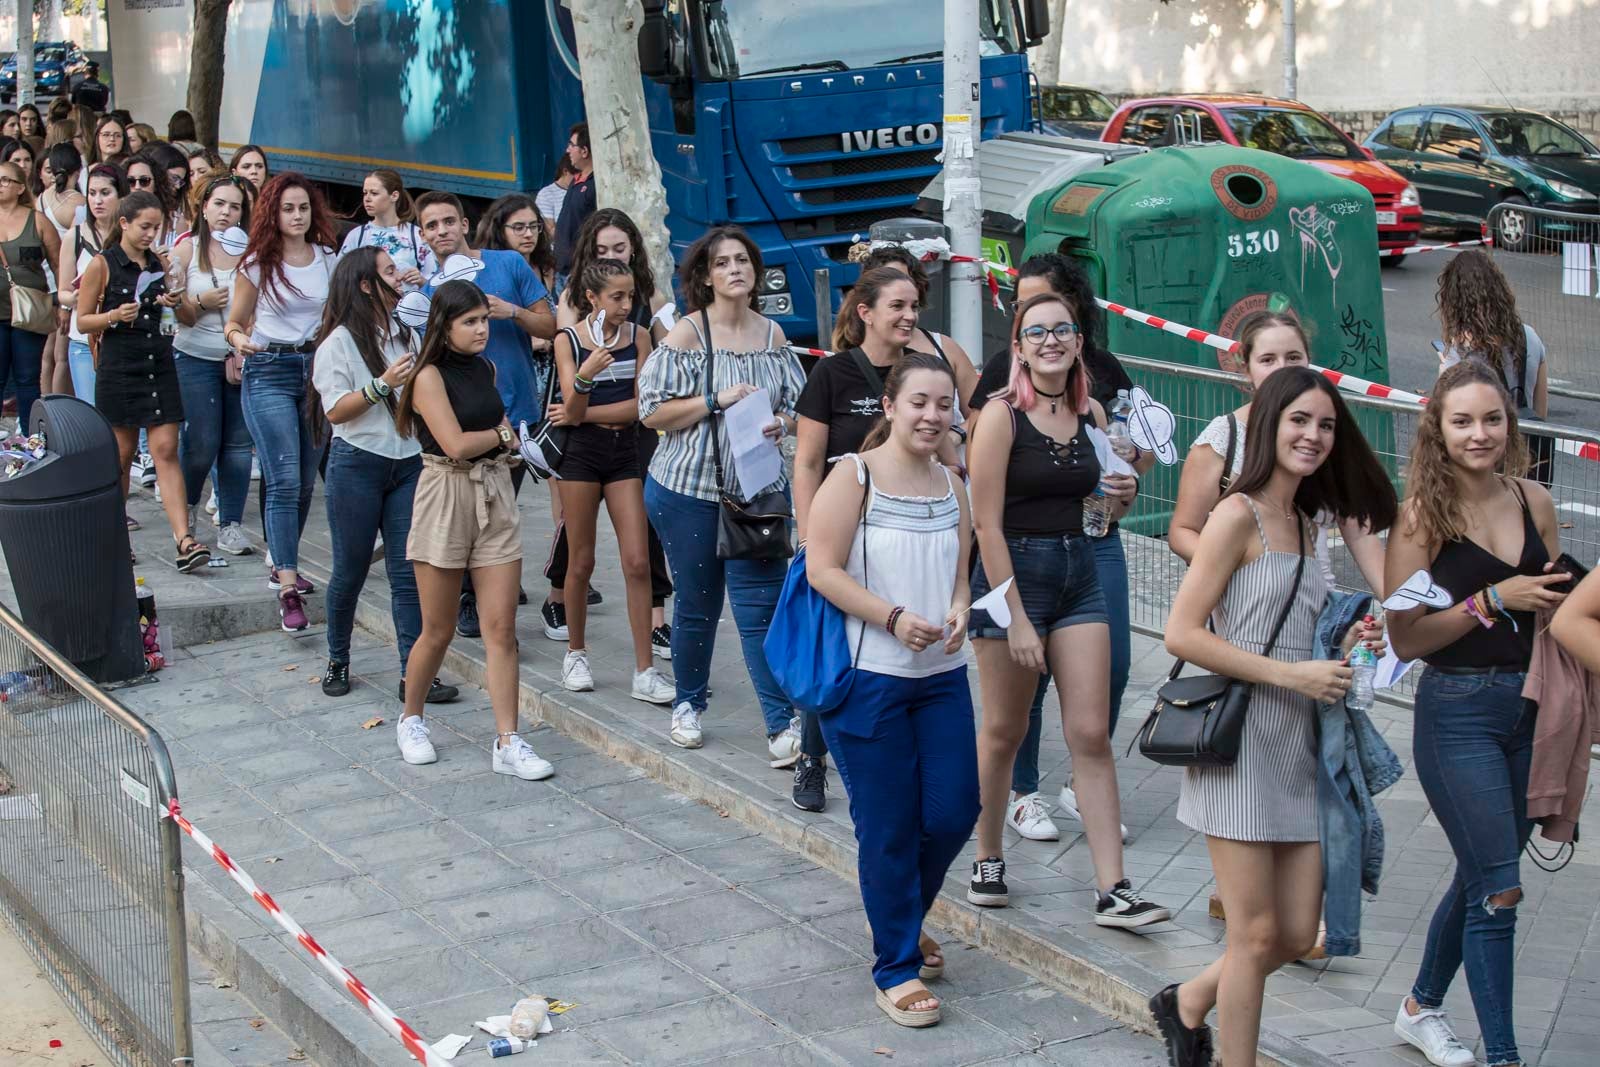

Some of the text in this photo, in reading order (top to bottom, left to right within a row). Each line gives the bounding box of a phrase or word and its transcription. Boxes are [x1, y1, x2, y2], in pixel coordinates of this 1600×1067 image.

[790, 70, 927, 92] STRAL
[842, 123, 938, 153] IVECO
[1227, 195, 1275, 218] DE VIDRIO
[1228, 229, 1280, 257] 530
[1226, 305, 1245, 331] puede
